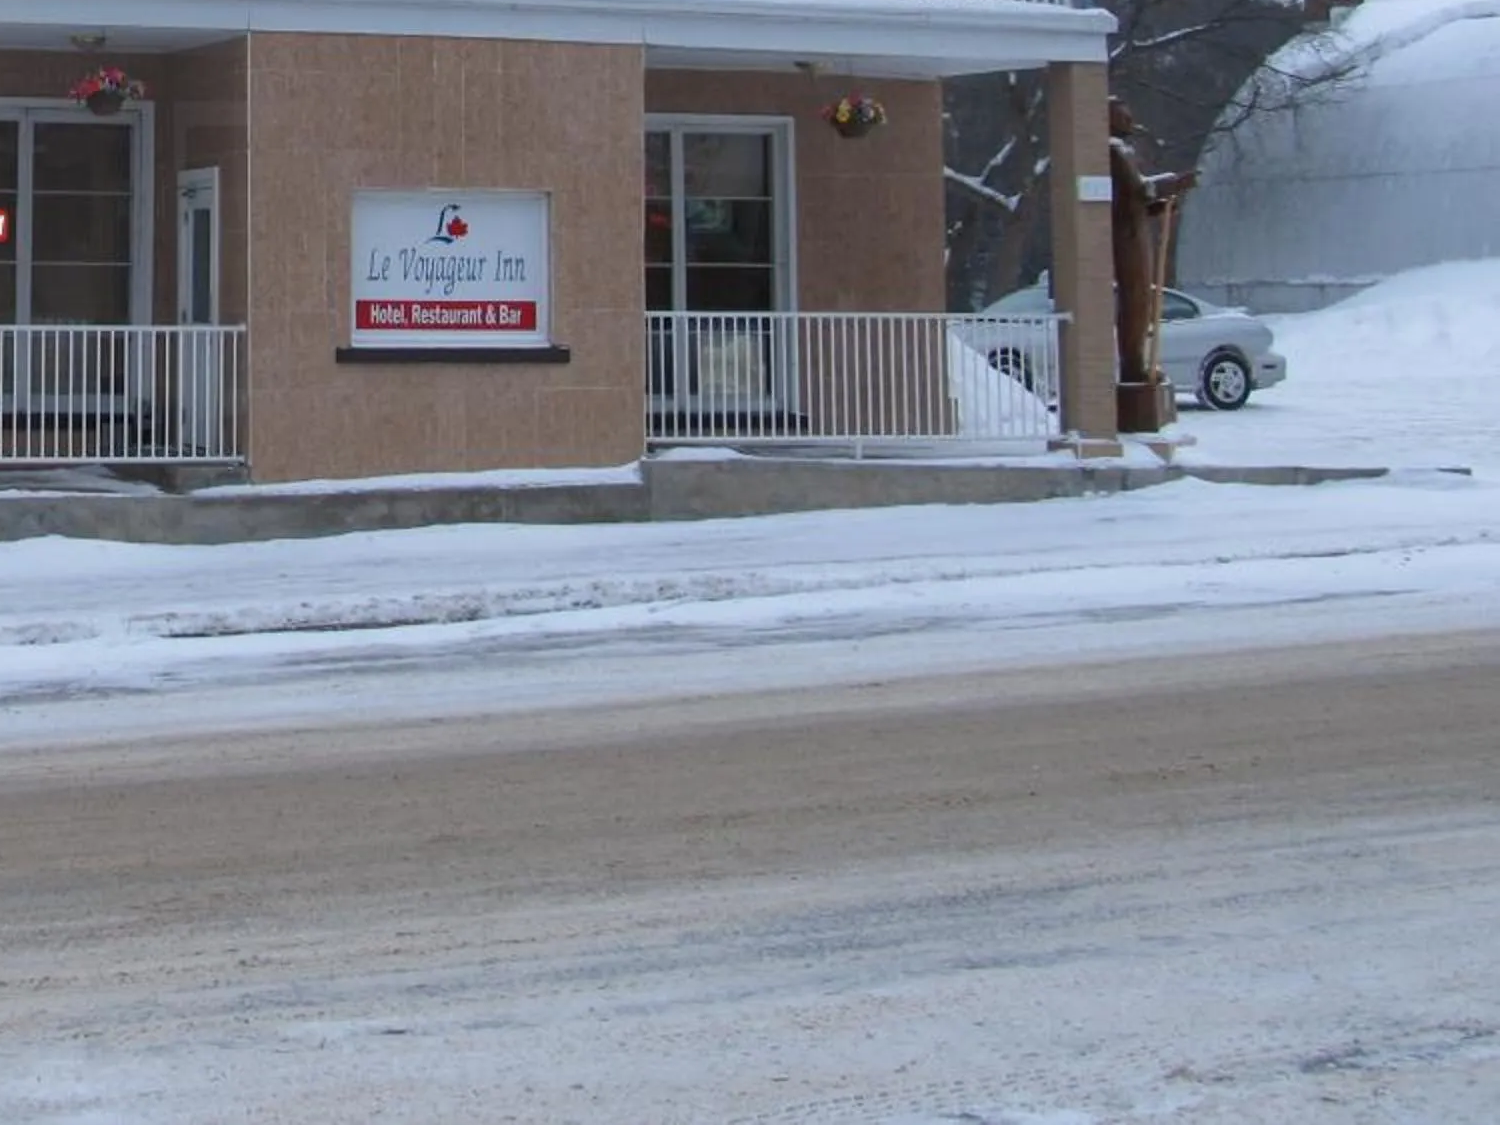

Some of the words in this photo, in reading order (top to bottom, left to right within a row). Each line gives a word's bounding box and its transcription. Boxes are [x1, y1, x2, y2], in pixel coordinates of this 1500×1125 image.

[367, 248, 391, 281] Le
[399, 247, 487, 295] Voyageur
[494, 250, 526, 282] Inn
[411, 305, 482, 325] Restaurant
[486, 306, 496, 325] &
[500, 305, 522, 325] Bar
